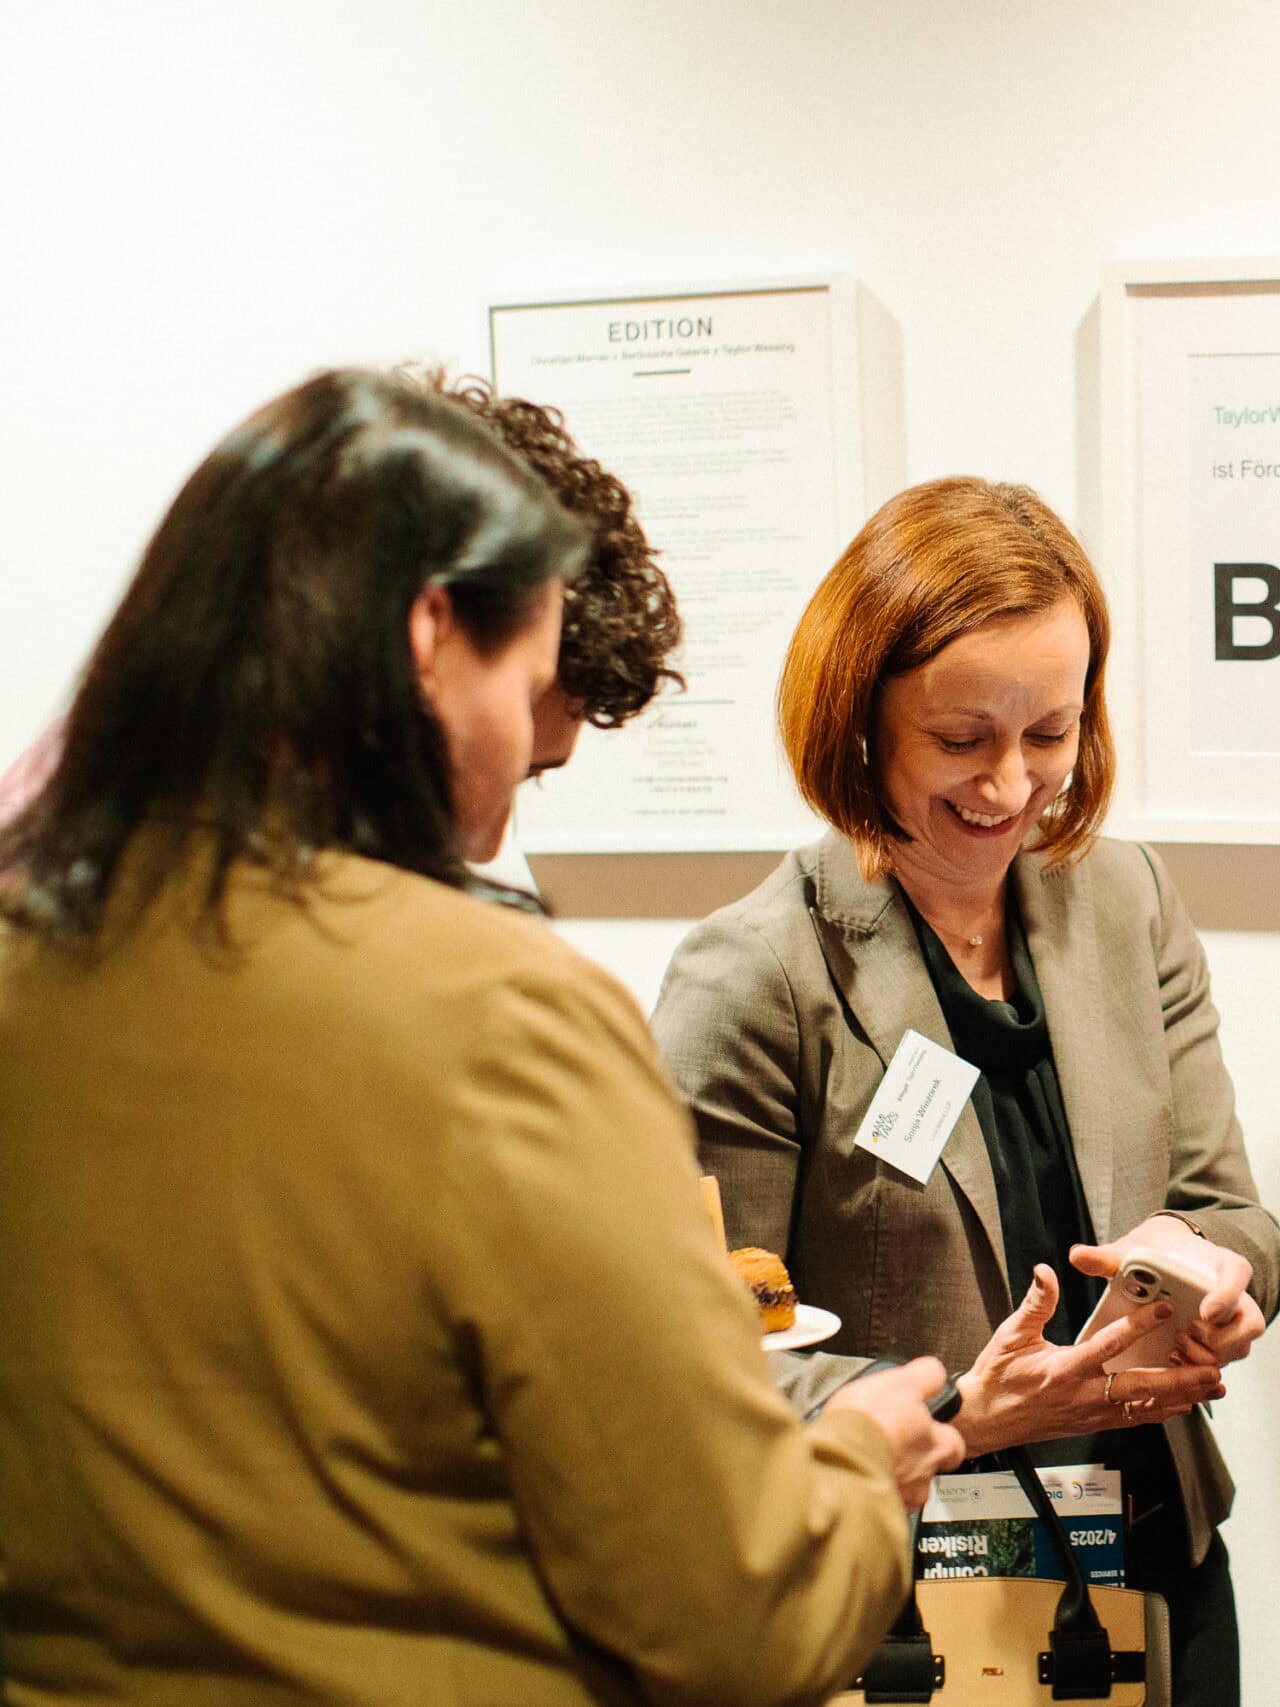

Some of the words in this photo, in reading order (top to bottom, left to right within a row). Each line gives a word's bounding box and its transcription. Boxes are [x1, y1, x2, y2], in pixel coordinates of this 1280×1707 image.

[607, 317, 714, 342] EDITION
[1212, 461, 1234, 479] ist
[1070, 1529, 1117, 1546] 4/2025
